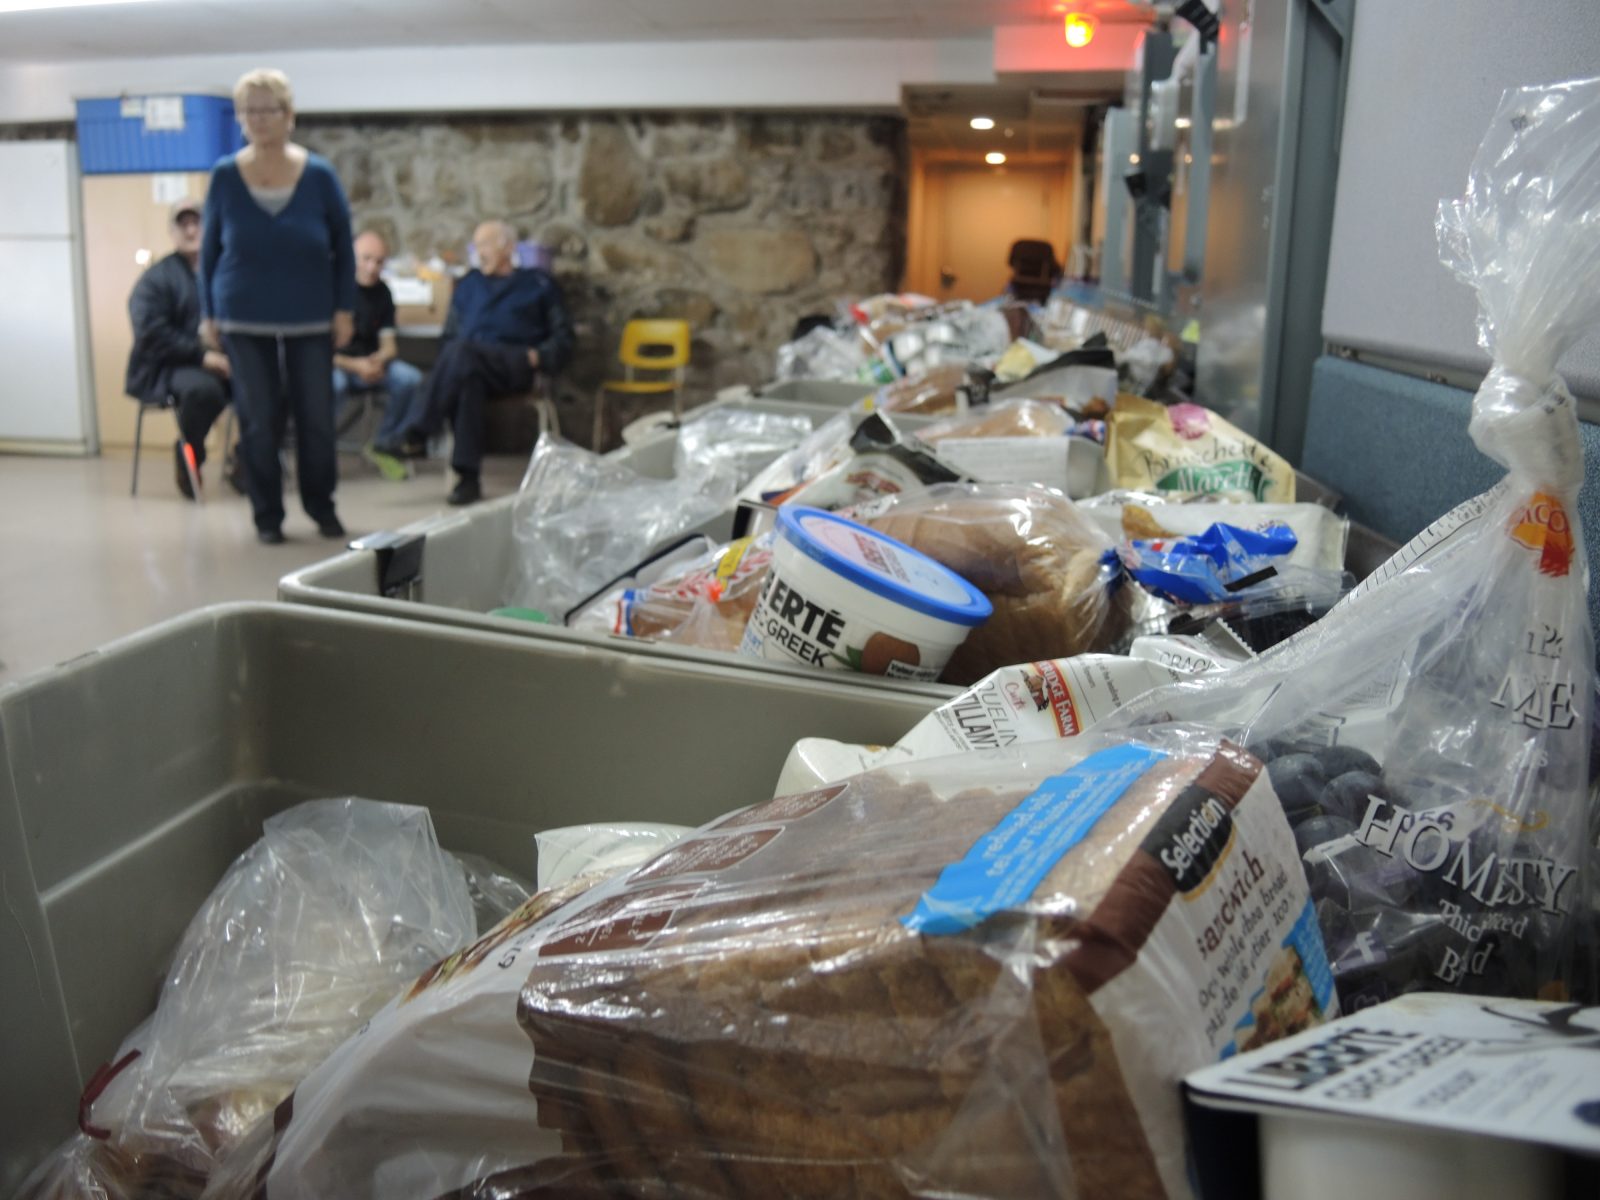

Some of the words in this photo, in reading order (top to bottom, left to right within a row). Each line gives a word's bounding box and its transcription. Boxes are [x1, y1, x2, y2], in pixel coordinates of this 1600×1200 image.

[767, 617, 832, 668] GREEK
[1056, 699, 1078, 736] FARM
[1160, 796, 1226, 881] Selection
